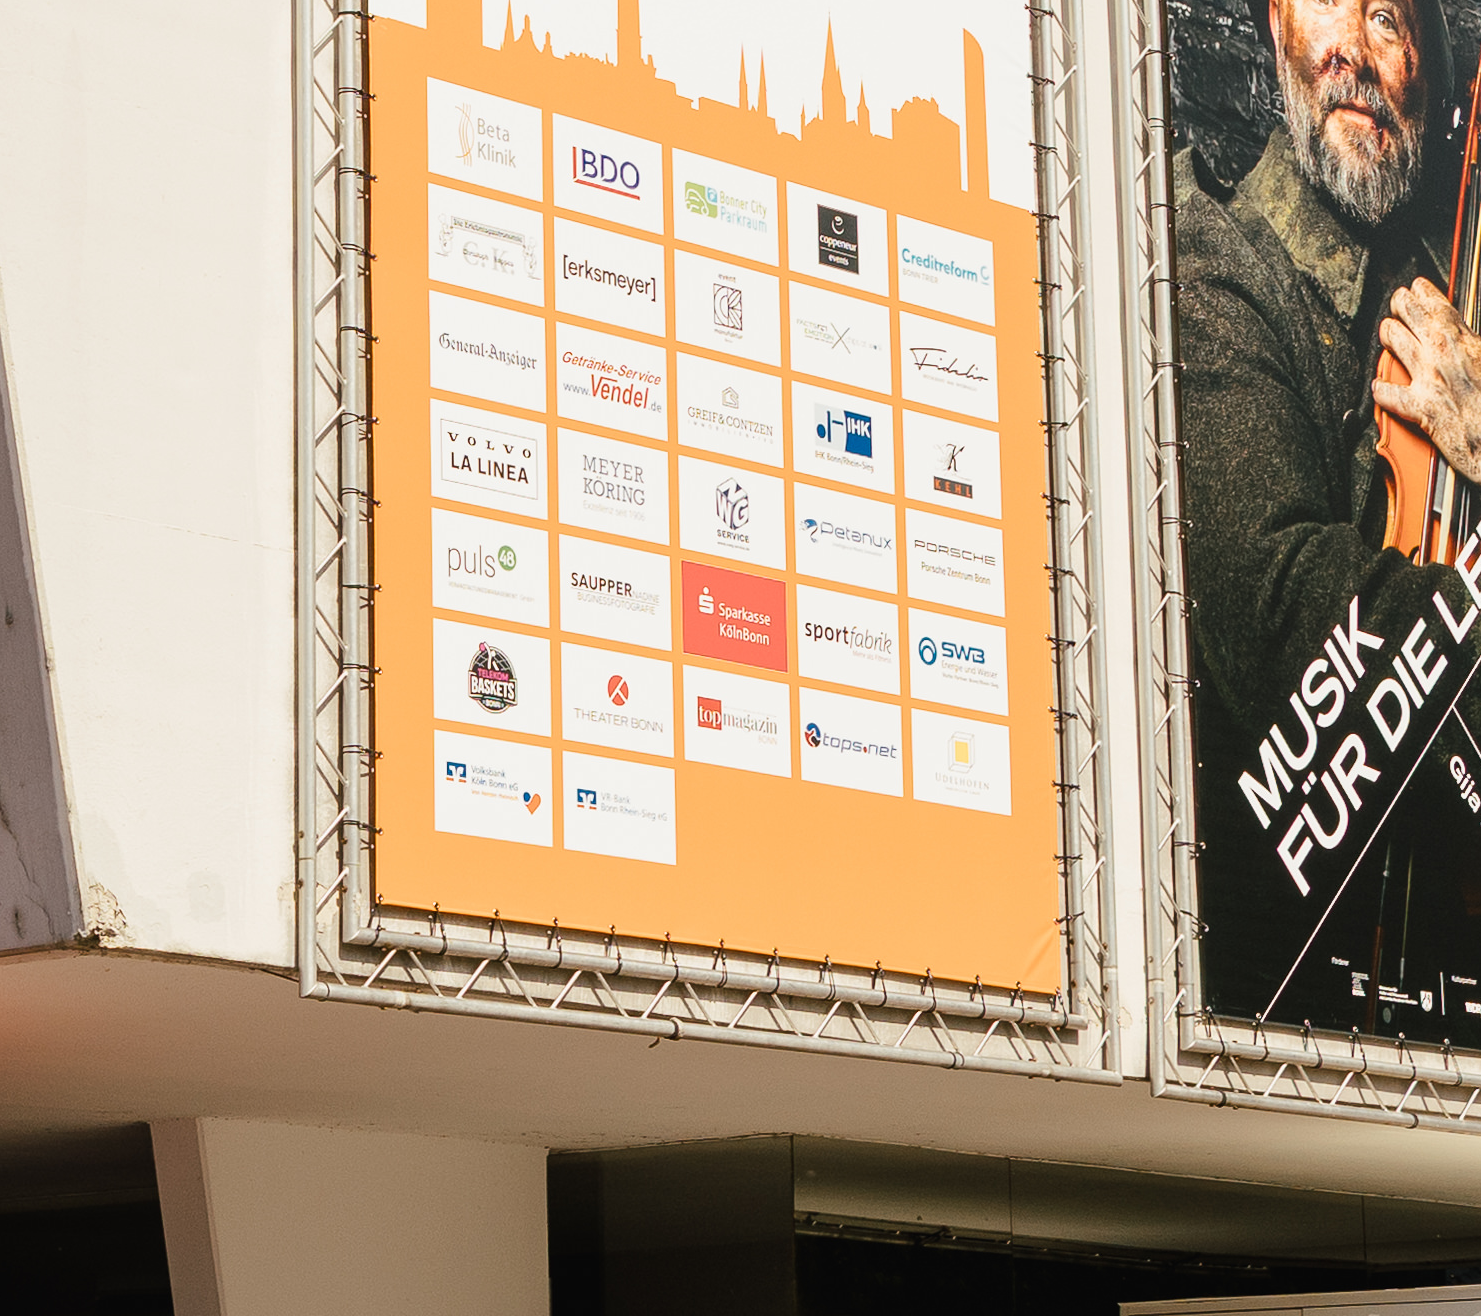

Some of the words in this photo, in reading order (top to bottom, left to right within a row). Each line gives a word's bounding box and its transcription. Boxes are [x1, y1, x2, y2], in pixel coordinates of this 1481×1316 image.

[477, 117, 511, 143] Beta
[477, 142, 517, 169] Klinik
[581, 148, 640, 190] BDO
[720, 190, 749, 212] Bonner
[750, 199, 768, 218] City
[720, 205, 768, 234] Parkraum
[563, 254, 656, 302] [erksmeyer]
[901, 247, 978, 282] Creditreform
[439, 332, 537, 371] General-Anzeiger
[562, 350, 662, 386] Getränke-Service
[845, 416, 871, 440] IHK
[447, 431, 532, 460] VOLVO
[451, 451, 472, 472] LA
[478, 457, 529, 485] LINEA
[582, 454, 645, 484] MEYER
[582, 476, 646, 507] KÖRING
[935, 477, 972, 498] KEHL
[717, 528, 750, 544] SERVICE
[820, 521, 893, 550] Petanux
[447, 544, 497, 579] puls
[499, 549, 517, 568] 48
[914, 539, 997, 566] PORSCHE
[571, 571, 633, 598] SAUPPER
[718, 602, 772, 627] Sparkasse
[719, 621, 770, 647] KölnBonn
[804, 621, 893, 655] sportfabrik
[941, 641, 986, 665] SWB
[470, 674, 516, 701] BASKETS
[573, 706, 629, 728] THEATER
[630, 715, 664, 733] BONN
[1238, 596, 1385, 831] MUSIK
[822, 731, 898, 759] tops.net
[1276, 732, 1382, 897] FÜR
[1373, 617, 1449, 755] DIE
[470, 764, 507, 779] Volksbank
[470, 775, 488, 787] Köln
[489, 778, 508, 790] Bonn
